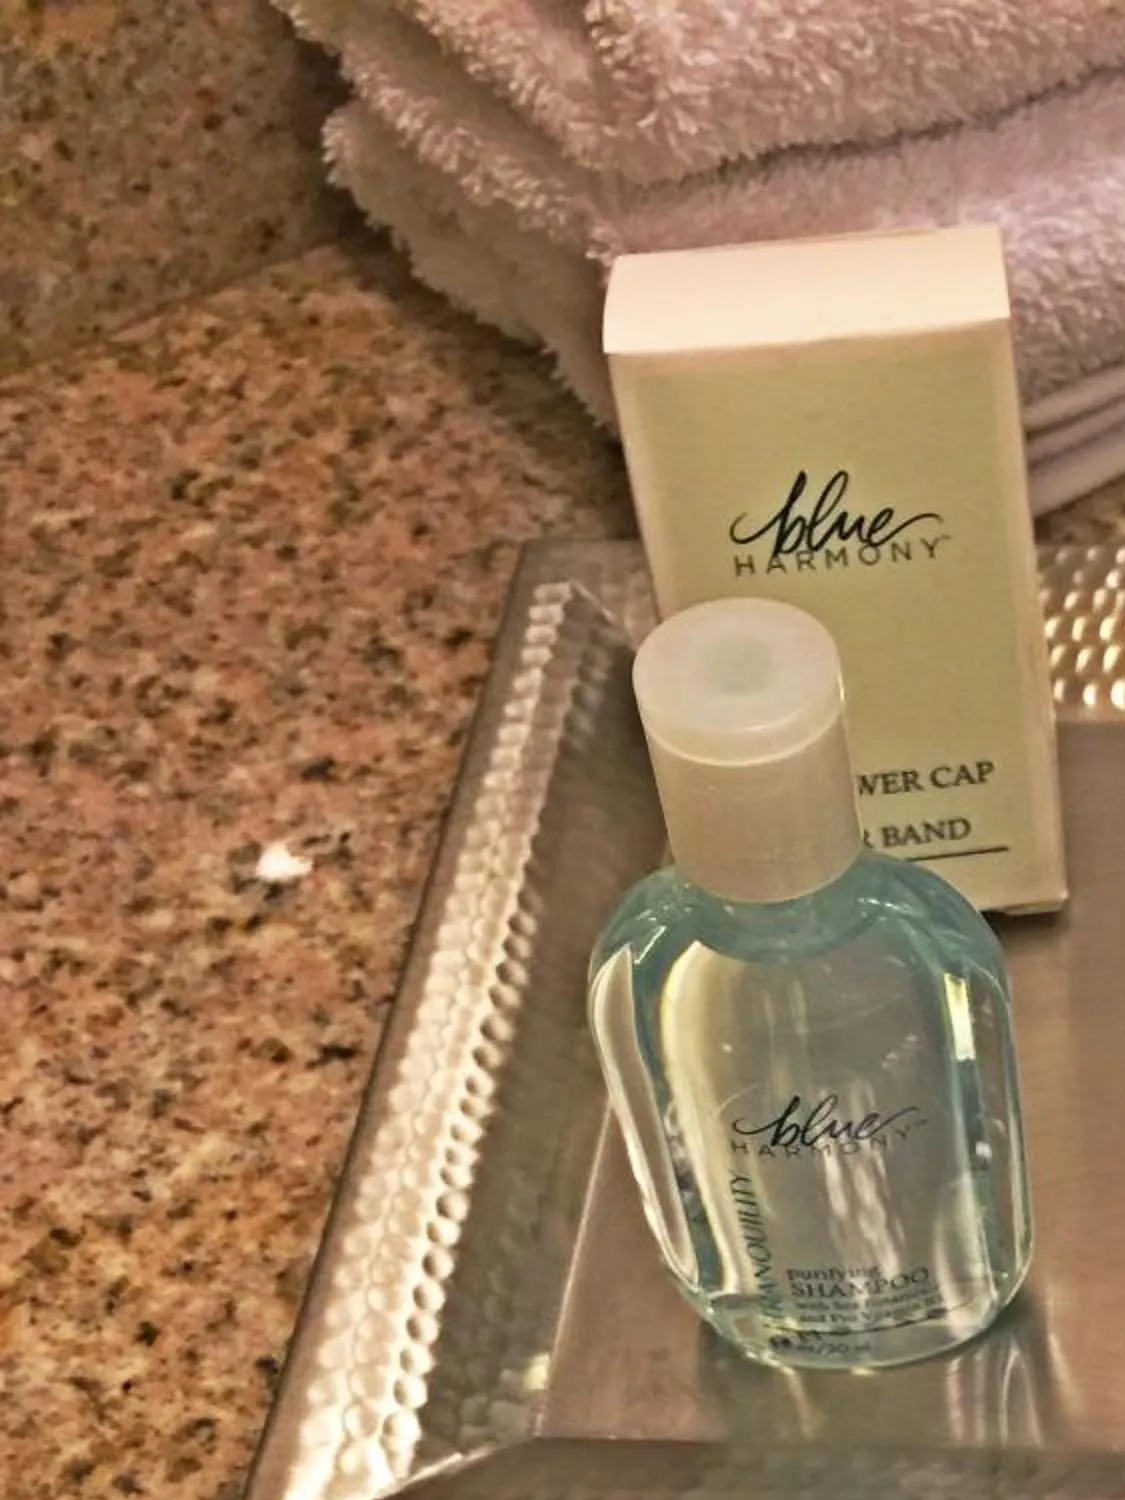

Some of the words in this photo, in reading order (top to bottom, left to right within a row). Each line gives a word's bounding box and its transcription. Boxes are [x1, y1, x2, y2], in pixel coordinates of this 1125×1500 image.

[729, 470, 946, 557] blue
[733, 540, 940, 577] HARMONY
[857, 768, 925, 796] WER
[929, 761, 995, 789] CAP
[880, 817, 972, 848] BAND
[731, 1094, 919, 1148] blue
[731, 1124, 912, 1160] HARMONY
[789, 1266, 930, 1299] SHAMPOO
